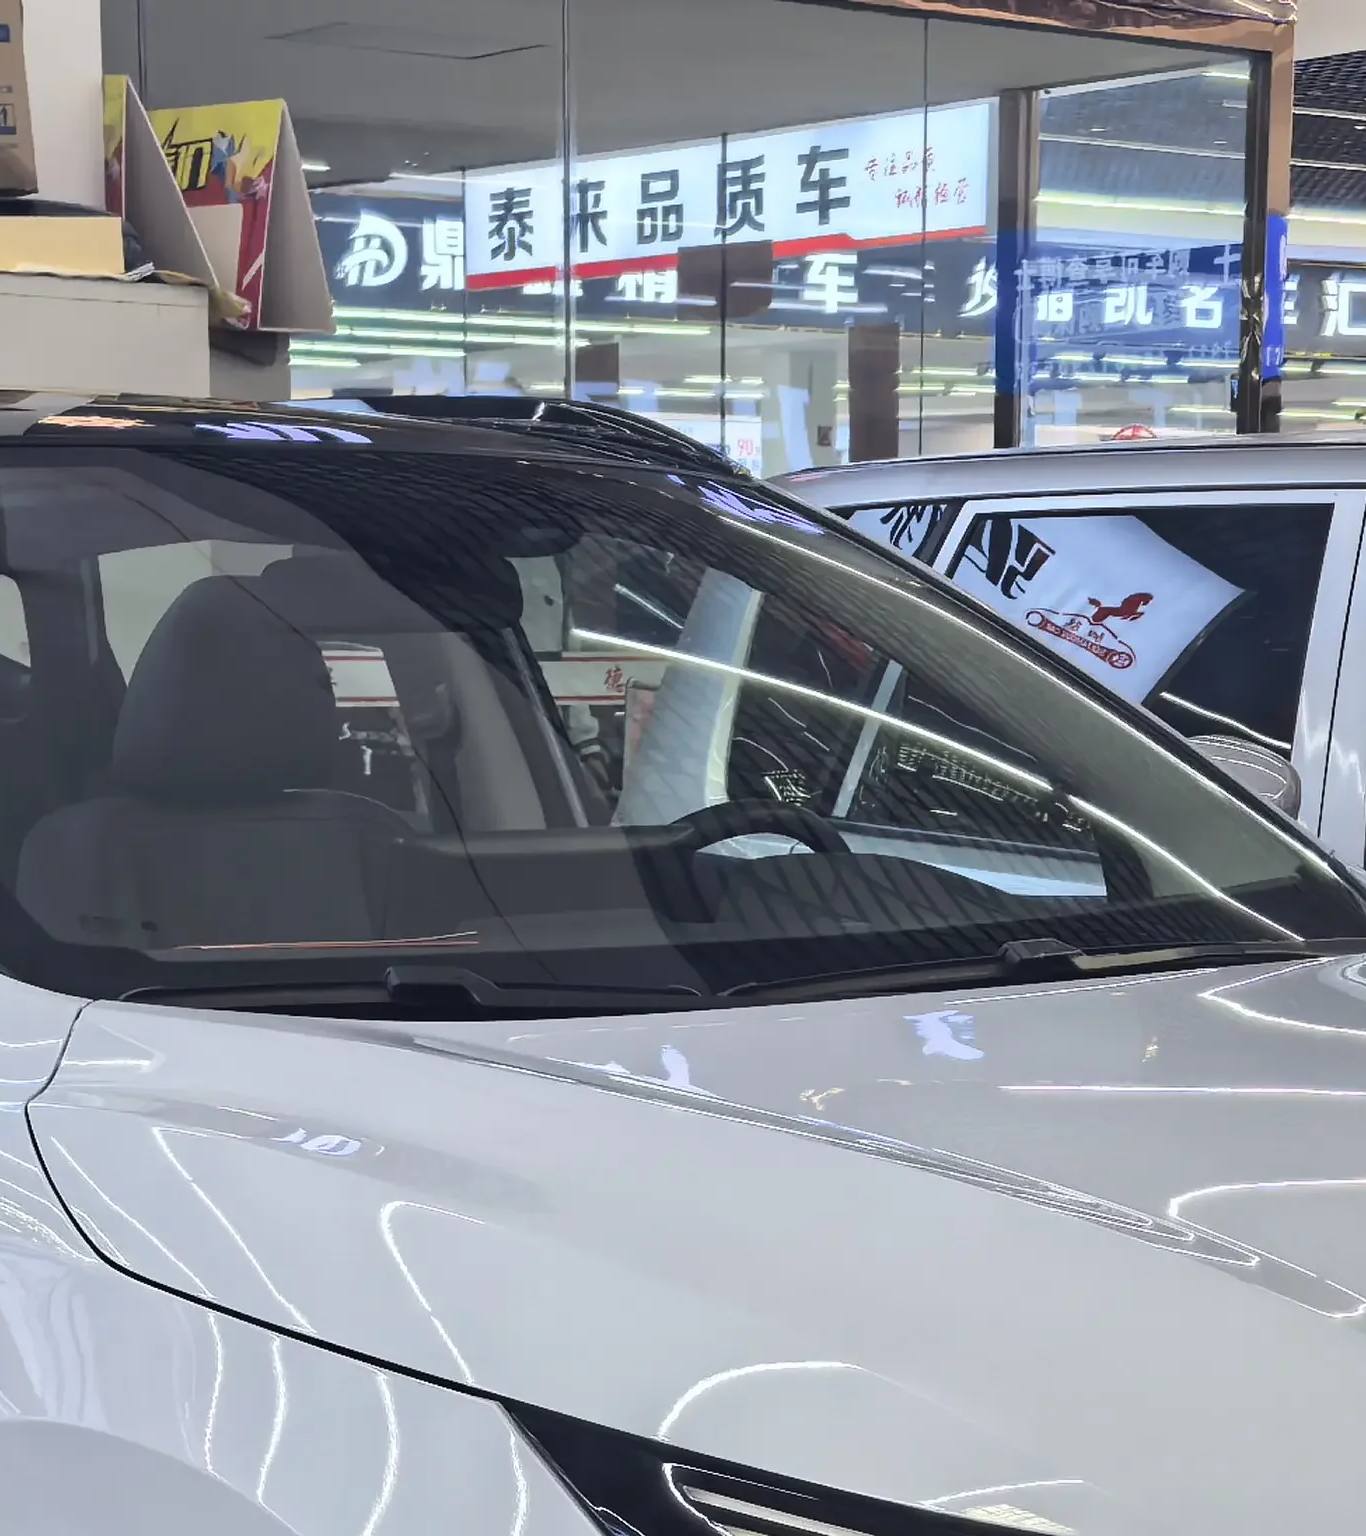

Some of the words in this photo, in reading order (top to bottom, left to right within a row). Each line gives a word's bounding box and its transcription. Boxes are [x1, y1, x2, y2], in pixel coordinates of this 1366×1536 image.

[488, 145, 851, 261] 泰来品质车
